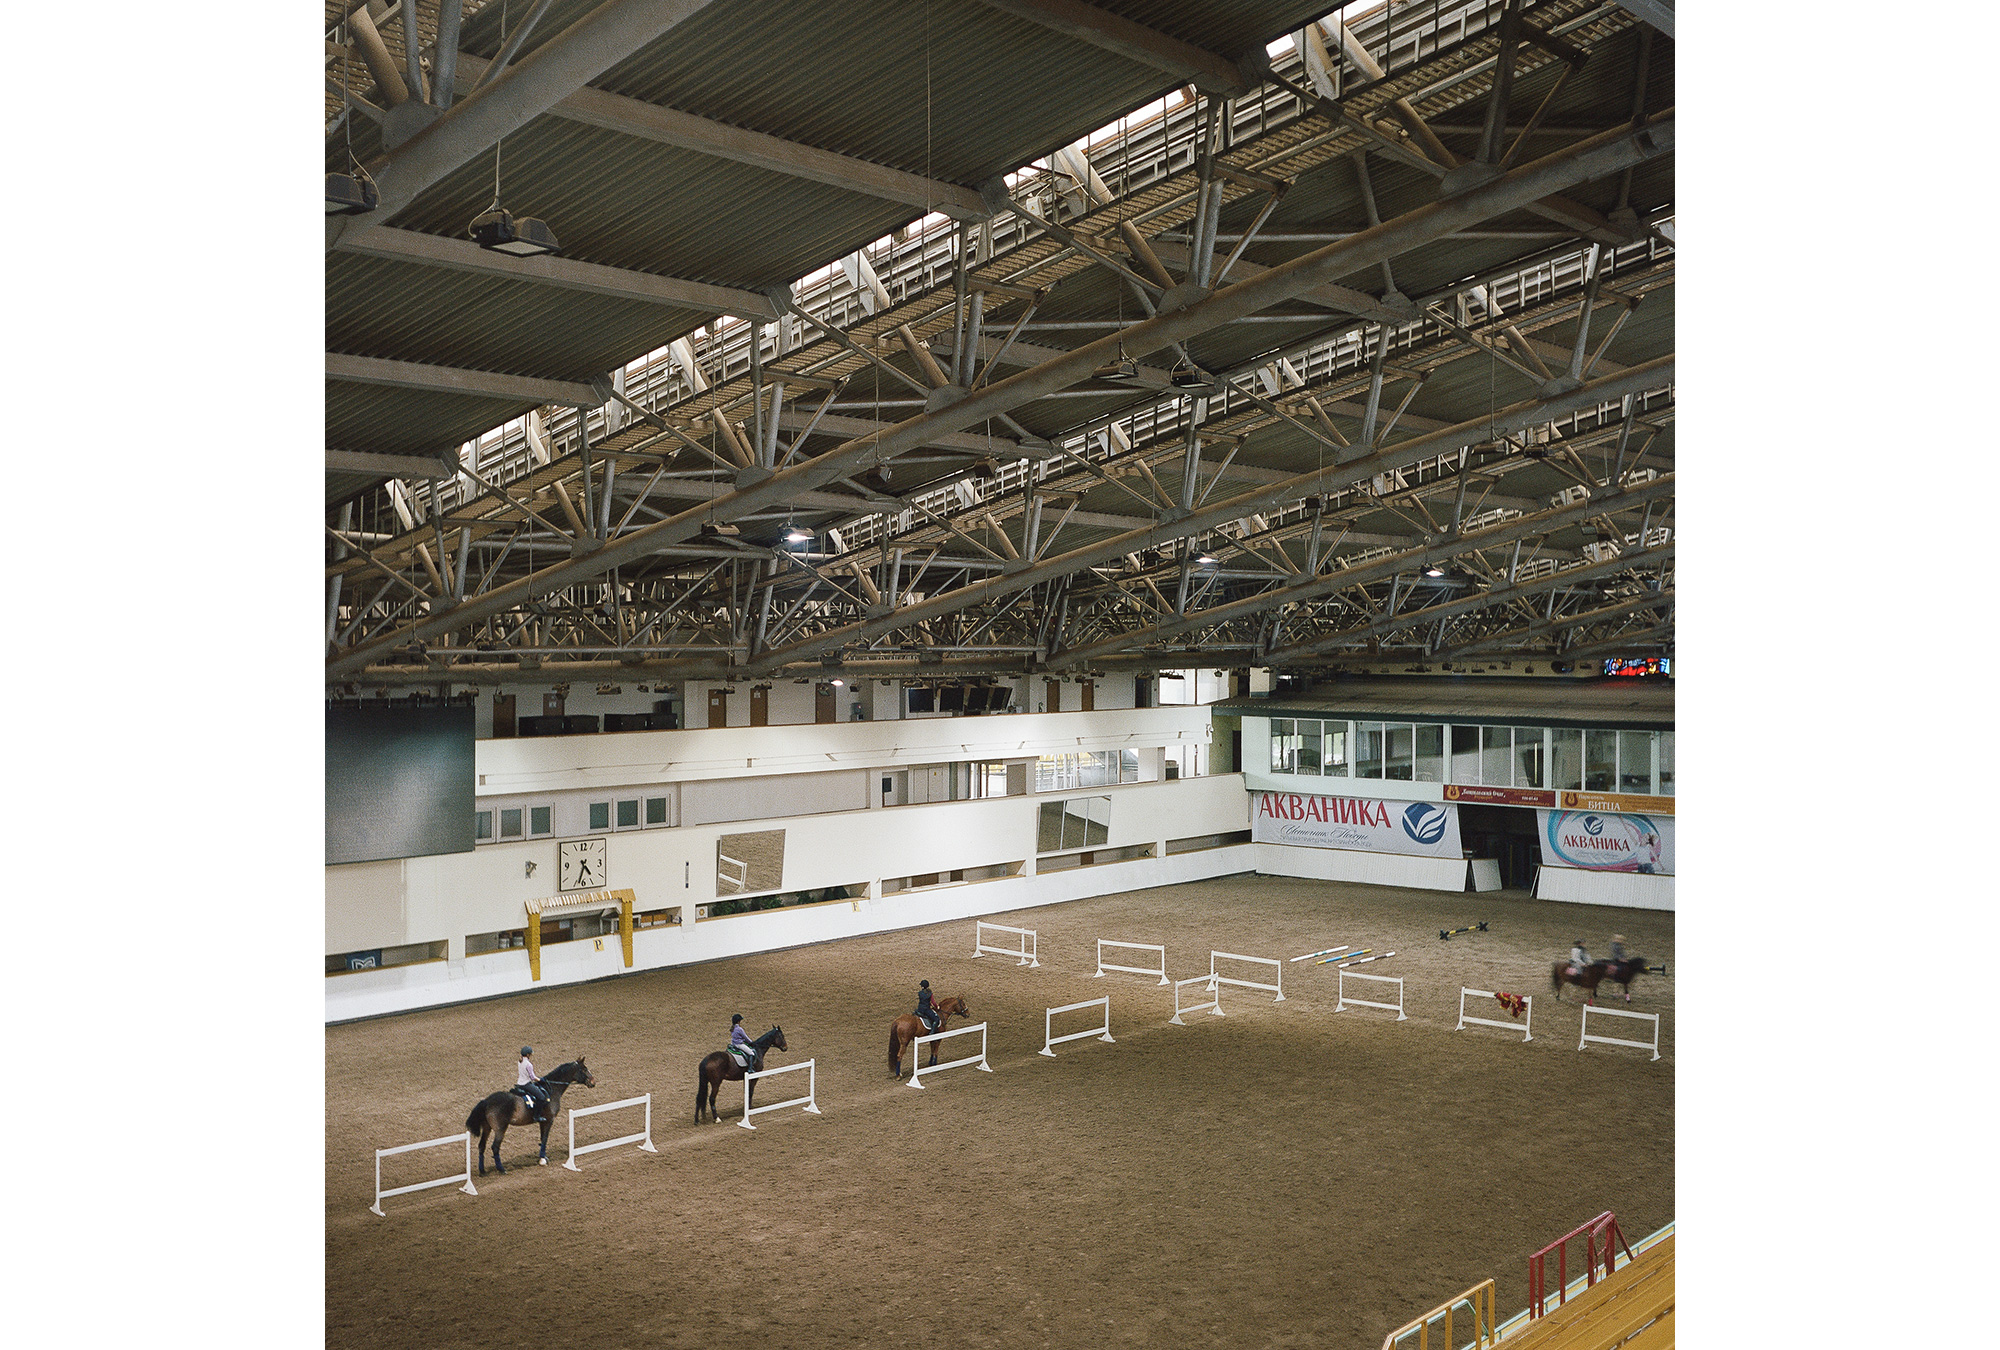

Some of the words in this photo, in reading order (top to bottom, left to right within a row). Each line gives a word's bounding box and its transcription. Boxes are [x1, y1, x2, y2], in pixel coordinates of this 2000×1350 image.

[1259, 792, 1392, 829] АКВАНИКА
[1588, 800, 1621, 811] БИТЦА
[580, 842, 588, 851] 12
[1562, 834, 1631, 852] АКВАНИКА
[564, 862, 570, 871] 9
[597, 858, 602, 868] 3
